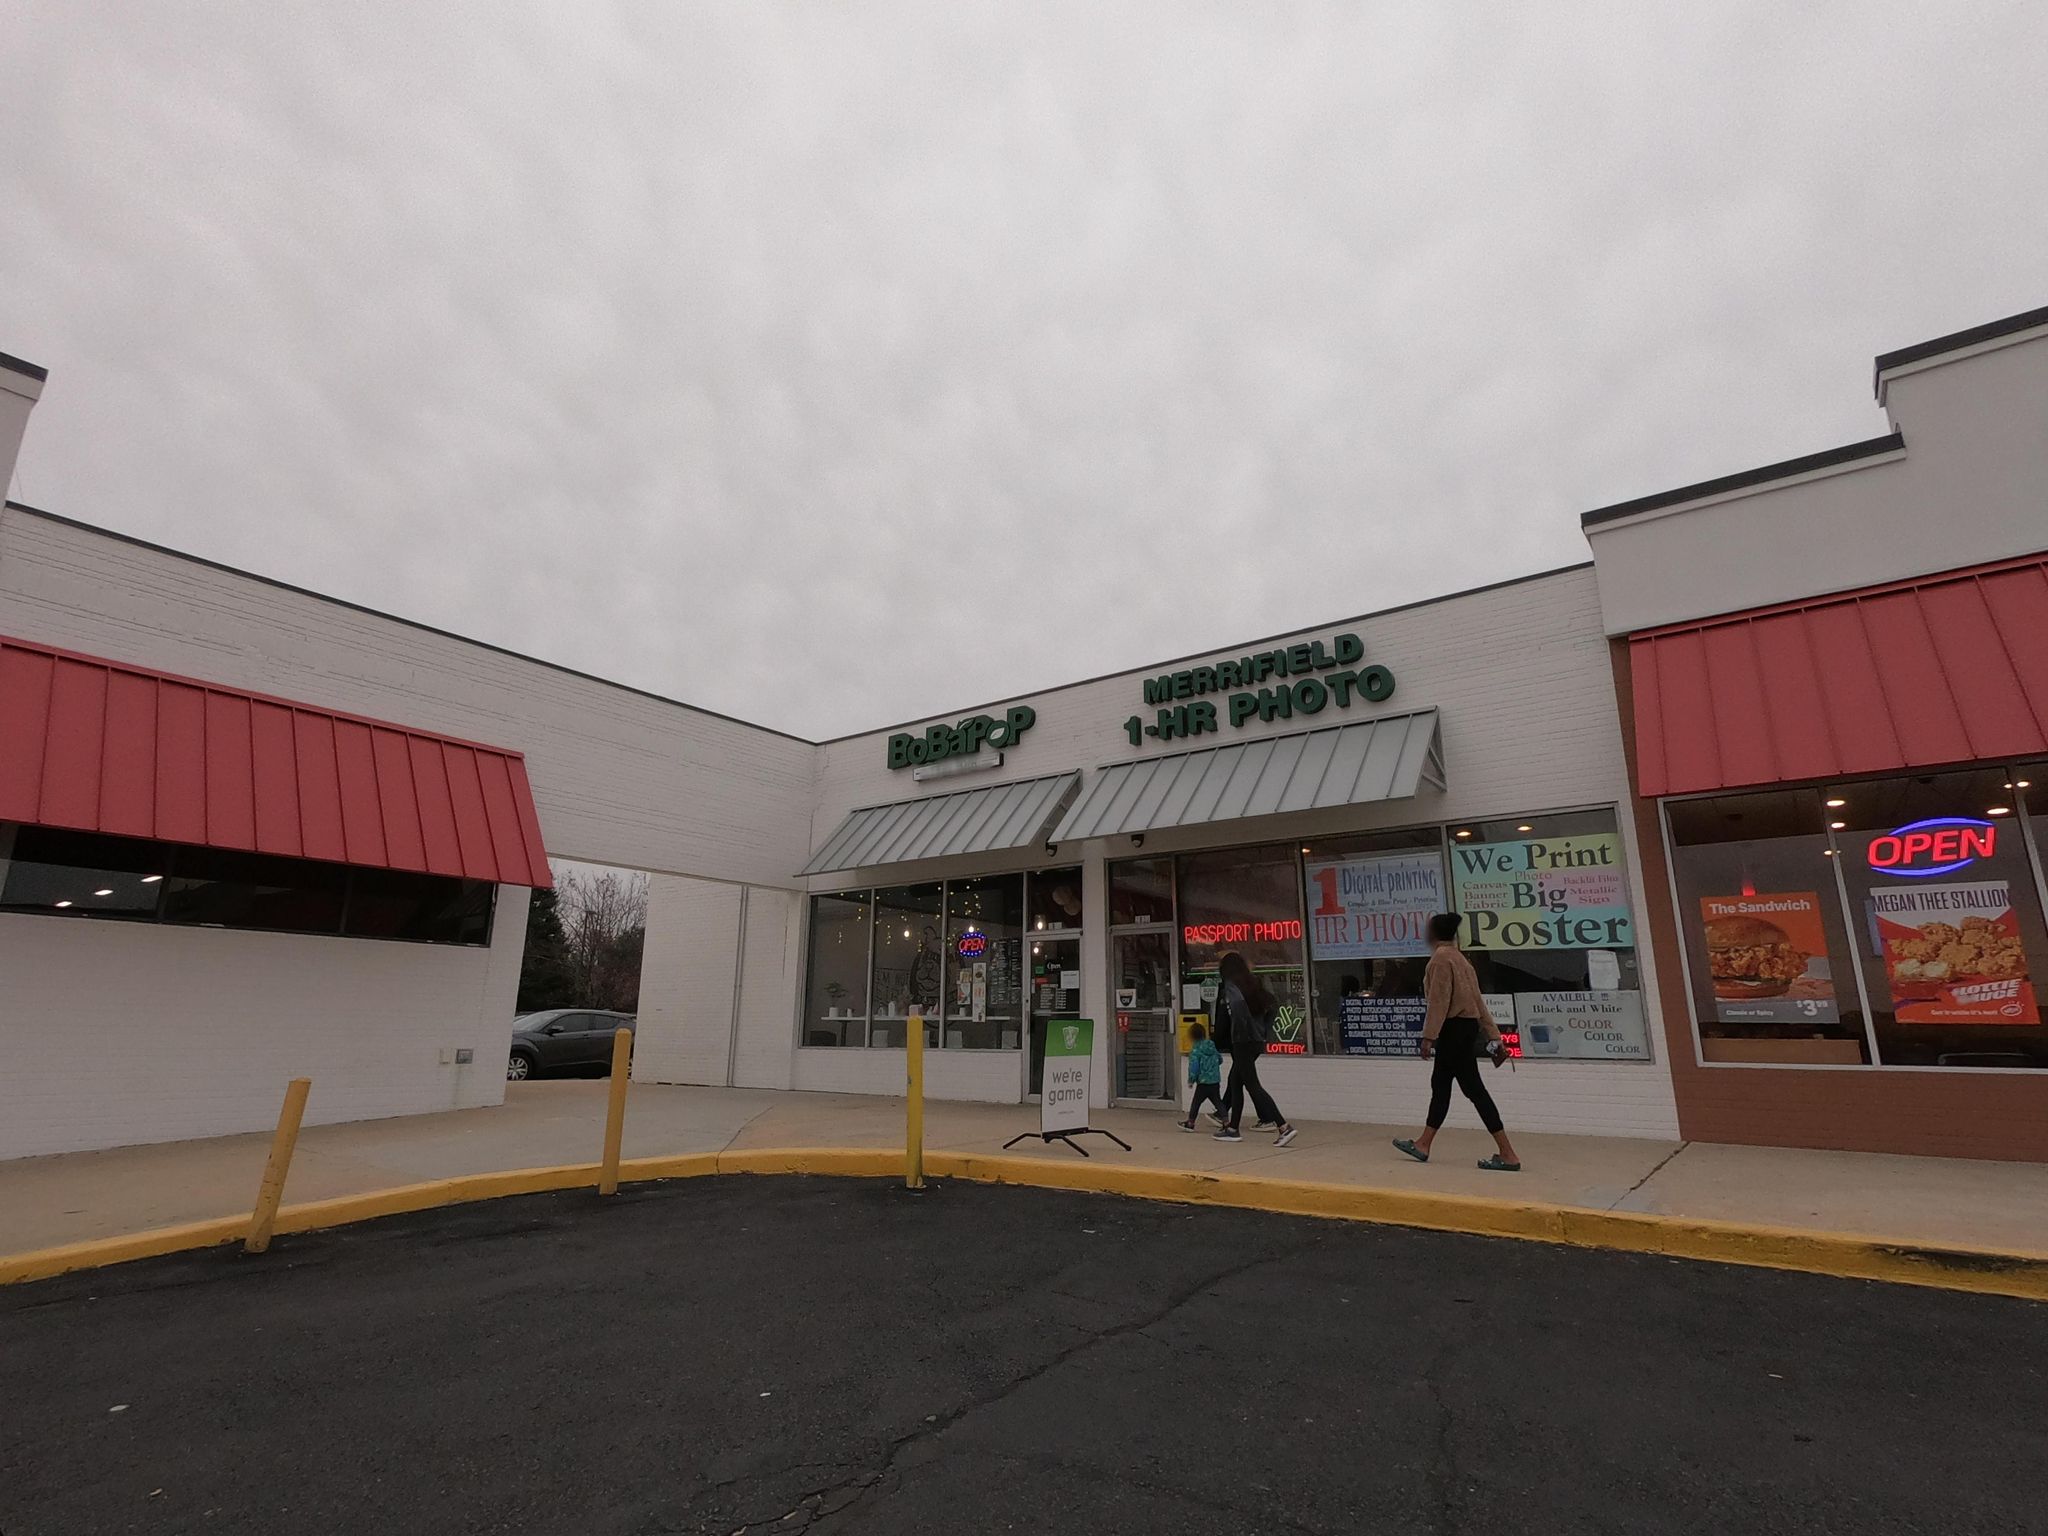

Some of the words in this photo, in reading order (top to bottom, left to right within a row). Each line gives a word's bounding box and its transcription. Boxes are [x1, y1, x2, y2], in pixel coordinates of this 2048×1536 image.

[1144, 633, 1364, 705] MERRIFIELD
[1124, 701, 1218, 746] 1-HR
[1229, 664, 1395, 727] PHOTO
[1867, 826, 1996, 867] OPEN
[1457, 848, 1514, 874] We
[1523, 841, 1613, 870] Print
[1515, 871, 1552, 881] Photo
[1312, 867, 1346, 916] 1
[1463, 881, 1508, 890] Canvas
[1570, 886, 1617, 895] Metallic
[1464, 890, 1508, 900] Banner
[1510, 881, 1569, 913] Big
[1872, 892, 1916, 913] MEGAN
[1917, 890, 1949, 911] THEE
[1950, 888, 2011, 910] STALLION
[1464, 900, 1509, 909] Fabric
[1708, 903, 1736, 914] The
[1738, 899, 1810, 913] Sandwich
[1184, 924, 1250, 944] PASSPORT
[1254, 920, 1301, 942] PHOTO
[1314, 914, 1349, 944] HR
[1463, 910, 1628, 948] Poster
[959, 938, 986, 952] OPEN
[1047, 962, 1061, 972] Open
[1532, 1004, 1562, 1013] Black
[1566, 1004, 1586, 1013] and
[1590, 1004, 1622, 1013] White
[1267, 1043, 1305, 1054] LOTTERY
[1052, 1068, 1083, 1083] we're
[1048, 1088, 1083, 1106] game
